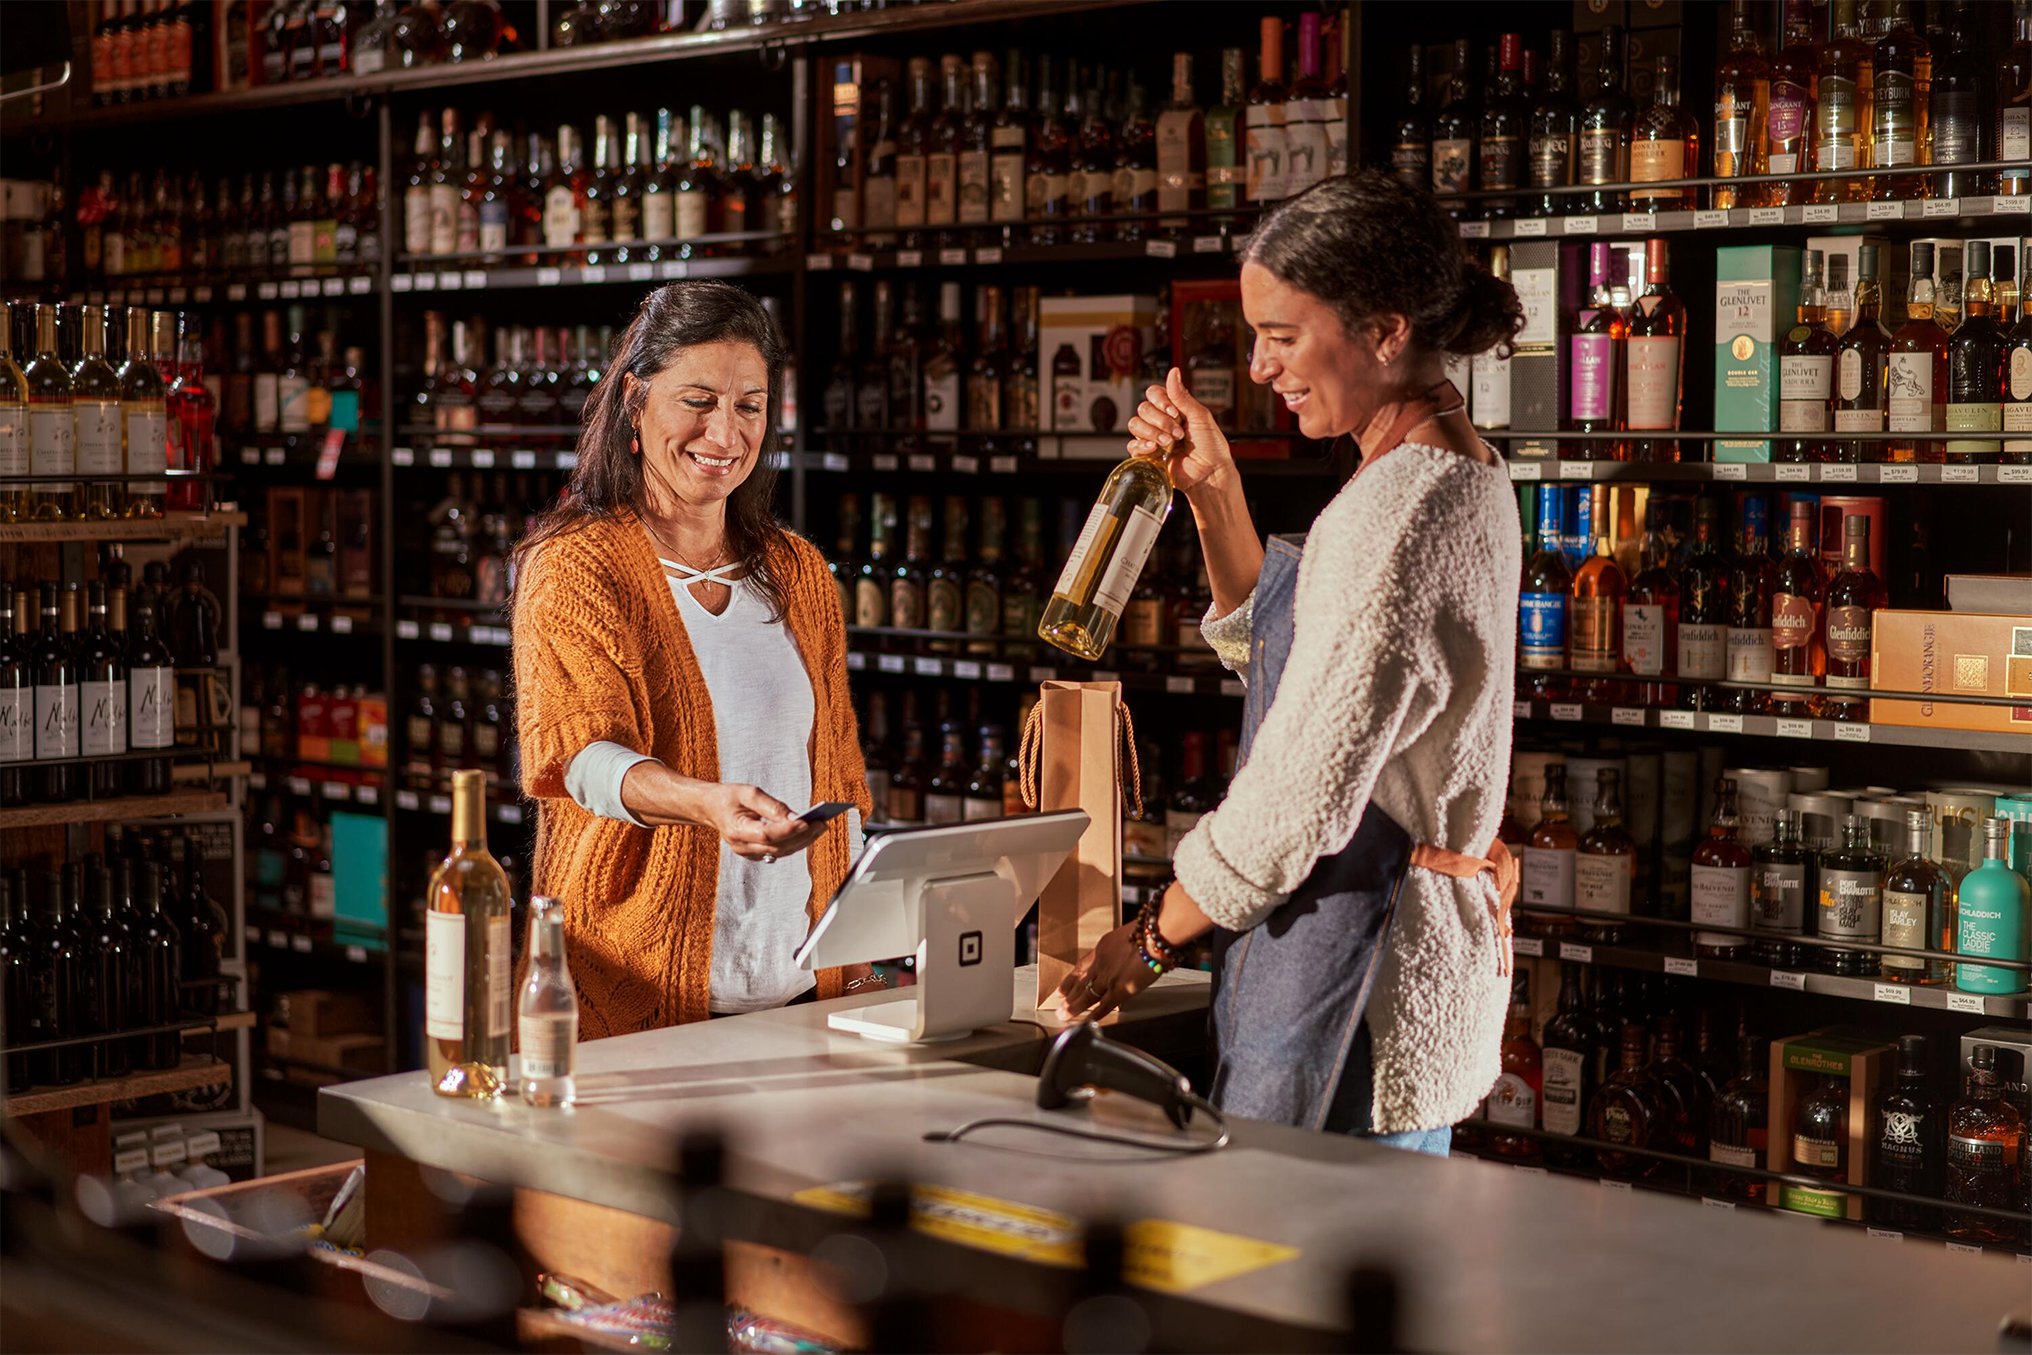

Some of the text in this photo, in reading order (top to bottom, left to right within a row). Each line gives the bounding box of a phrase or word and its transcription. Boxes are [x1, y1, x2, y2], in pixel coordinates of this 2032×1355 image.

[1737, 289, 1751, 297] THE
[1720, 295, 1767, 306] GLENLIVET
[1737, 307, 1750, 317] 12
[1919, 624, 1936, 718] GLNMORANGIE
[1963, 920, 1976, 931] THE
[1962, 929, 1996, 942] CLASSIC
[1962, 938, 1991, 950] LADDIE
[1881, 1141, 1922, 1154] MAGNUS
